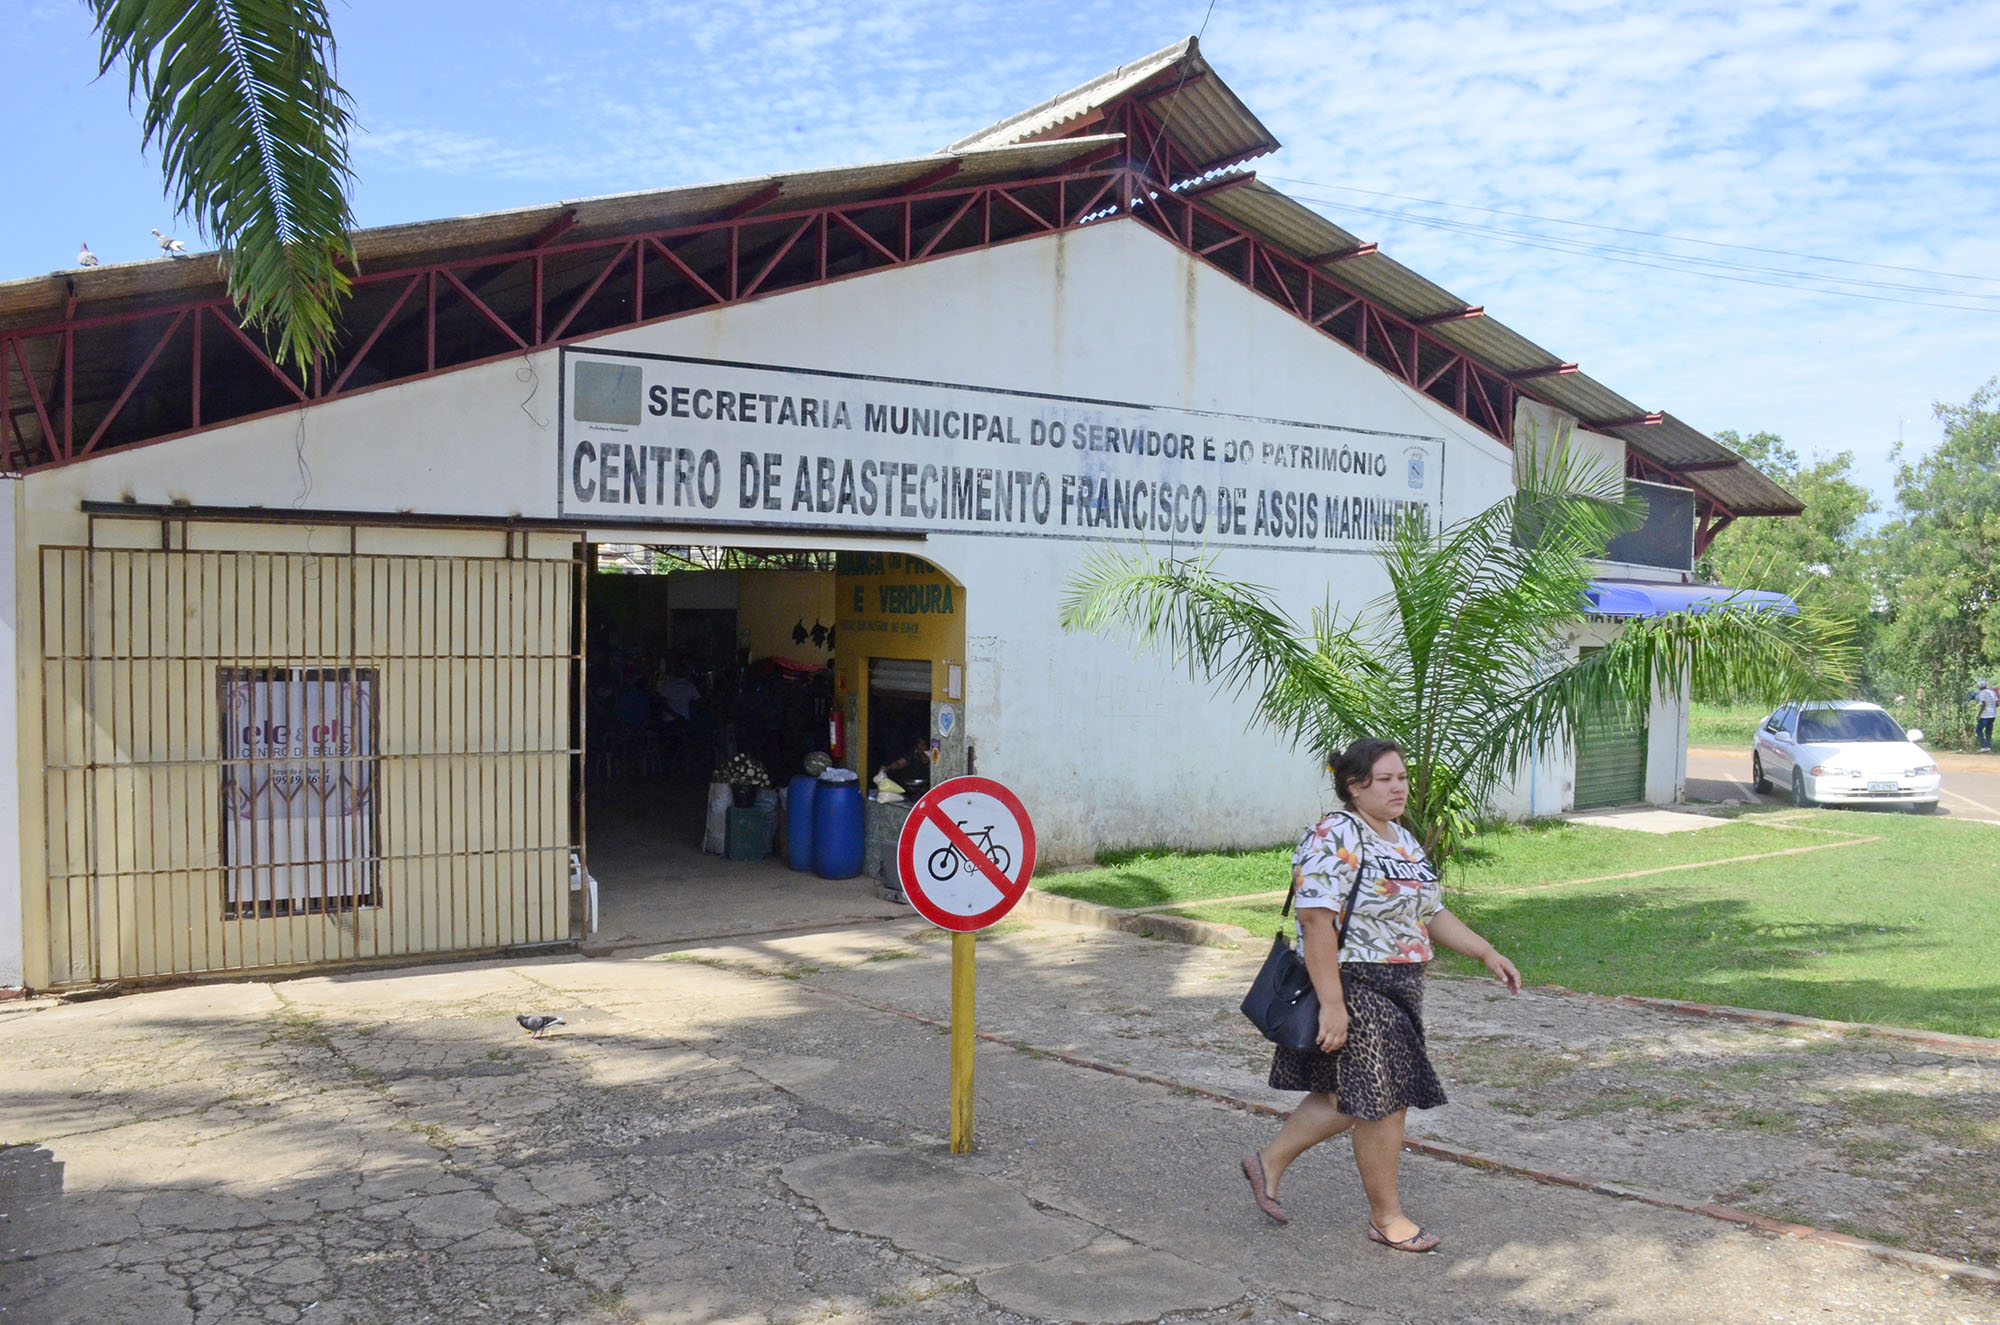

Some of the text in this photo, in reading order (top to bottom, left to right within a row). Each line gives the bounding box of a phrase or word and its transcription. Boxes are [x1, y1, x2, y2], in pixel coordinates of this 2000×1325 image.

[648, 384, 1387, 477] SECRETARIA MUNICIPAL DO SERVIDOR E DO PATRIMÔNIO
[573, 440, 721, 510] CENTRO
[739, 450, 782, 511] DE
[791, 455, 1050, 526] ABASTECIMENTO
[1061, 474, 1207, 534] FRANCISCO
[1218, 486, 1247, 536] DE
[1254, 490, 1319, 539] ASSIS
[853, 583, 953, 614] E VERDURA
[242, 719, 291, 745] ele
